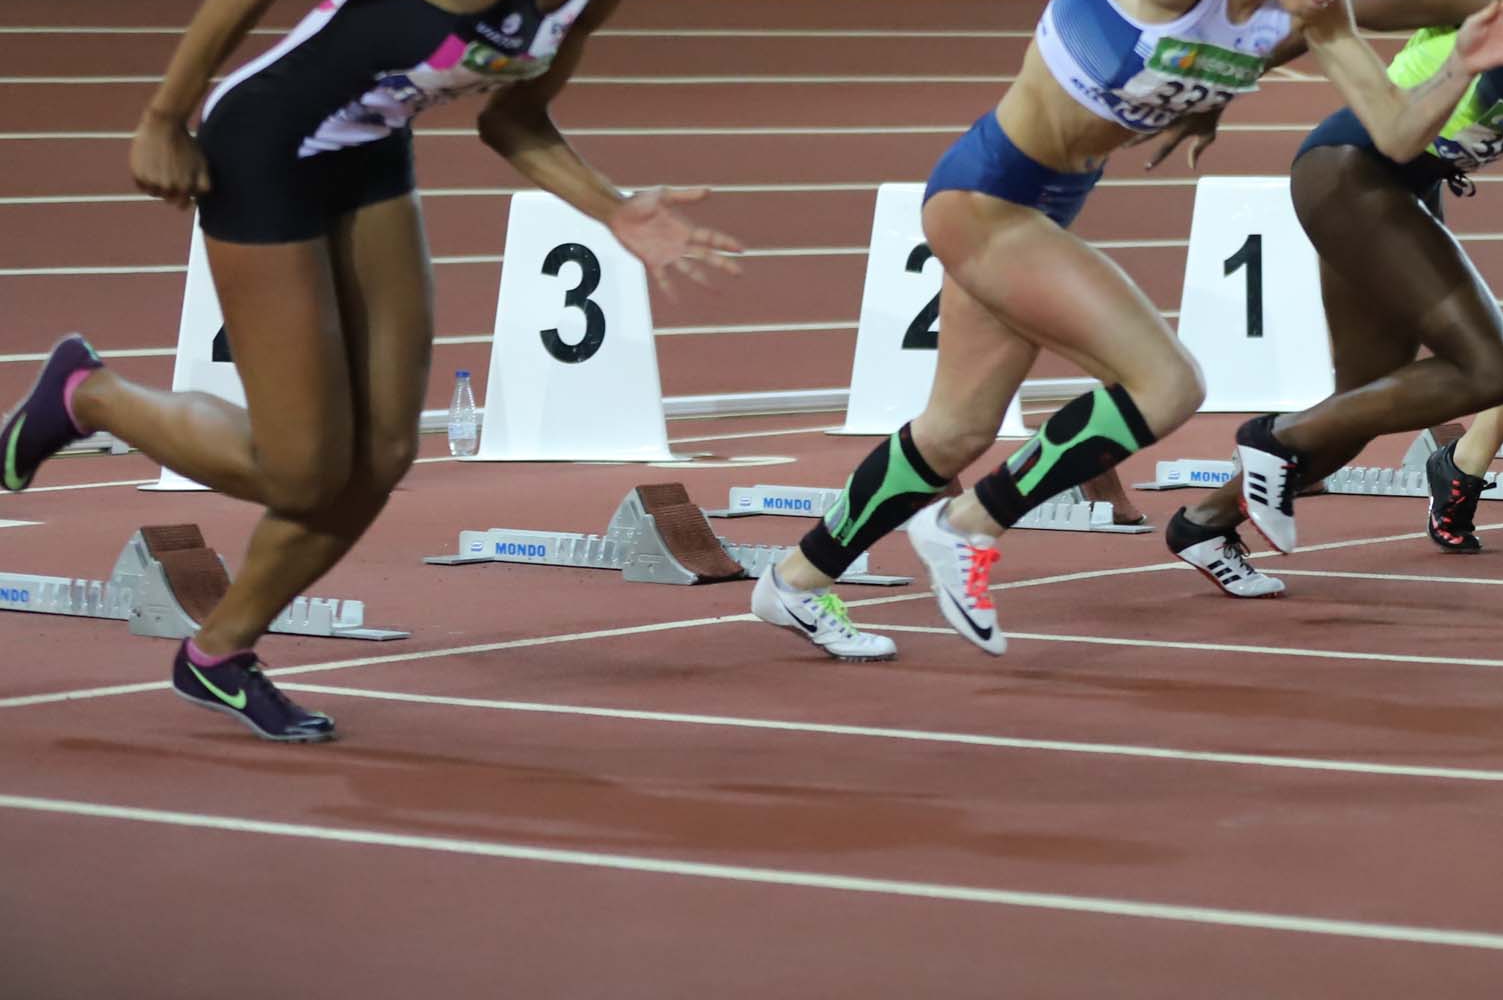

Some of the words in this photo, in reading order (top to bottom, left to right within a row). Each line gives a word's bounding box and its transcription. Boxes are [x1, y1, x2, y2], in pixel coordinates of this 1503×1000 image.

[1223, 234, 1263, 338] 1
[540, 242, 607, 364] 3
[1190, 471, 1234, 482] MOND
[763, 498, 812, 511] MONDO
[495, 542, 546, 557] MONDO
